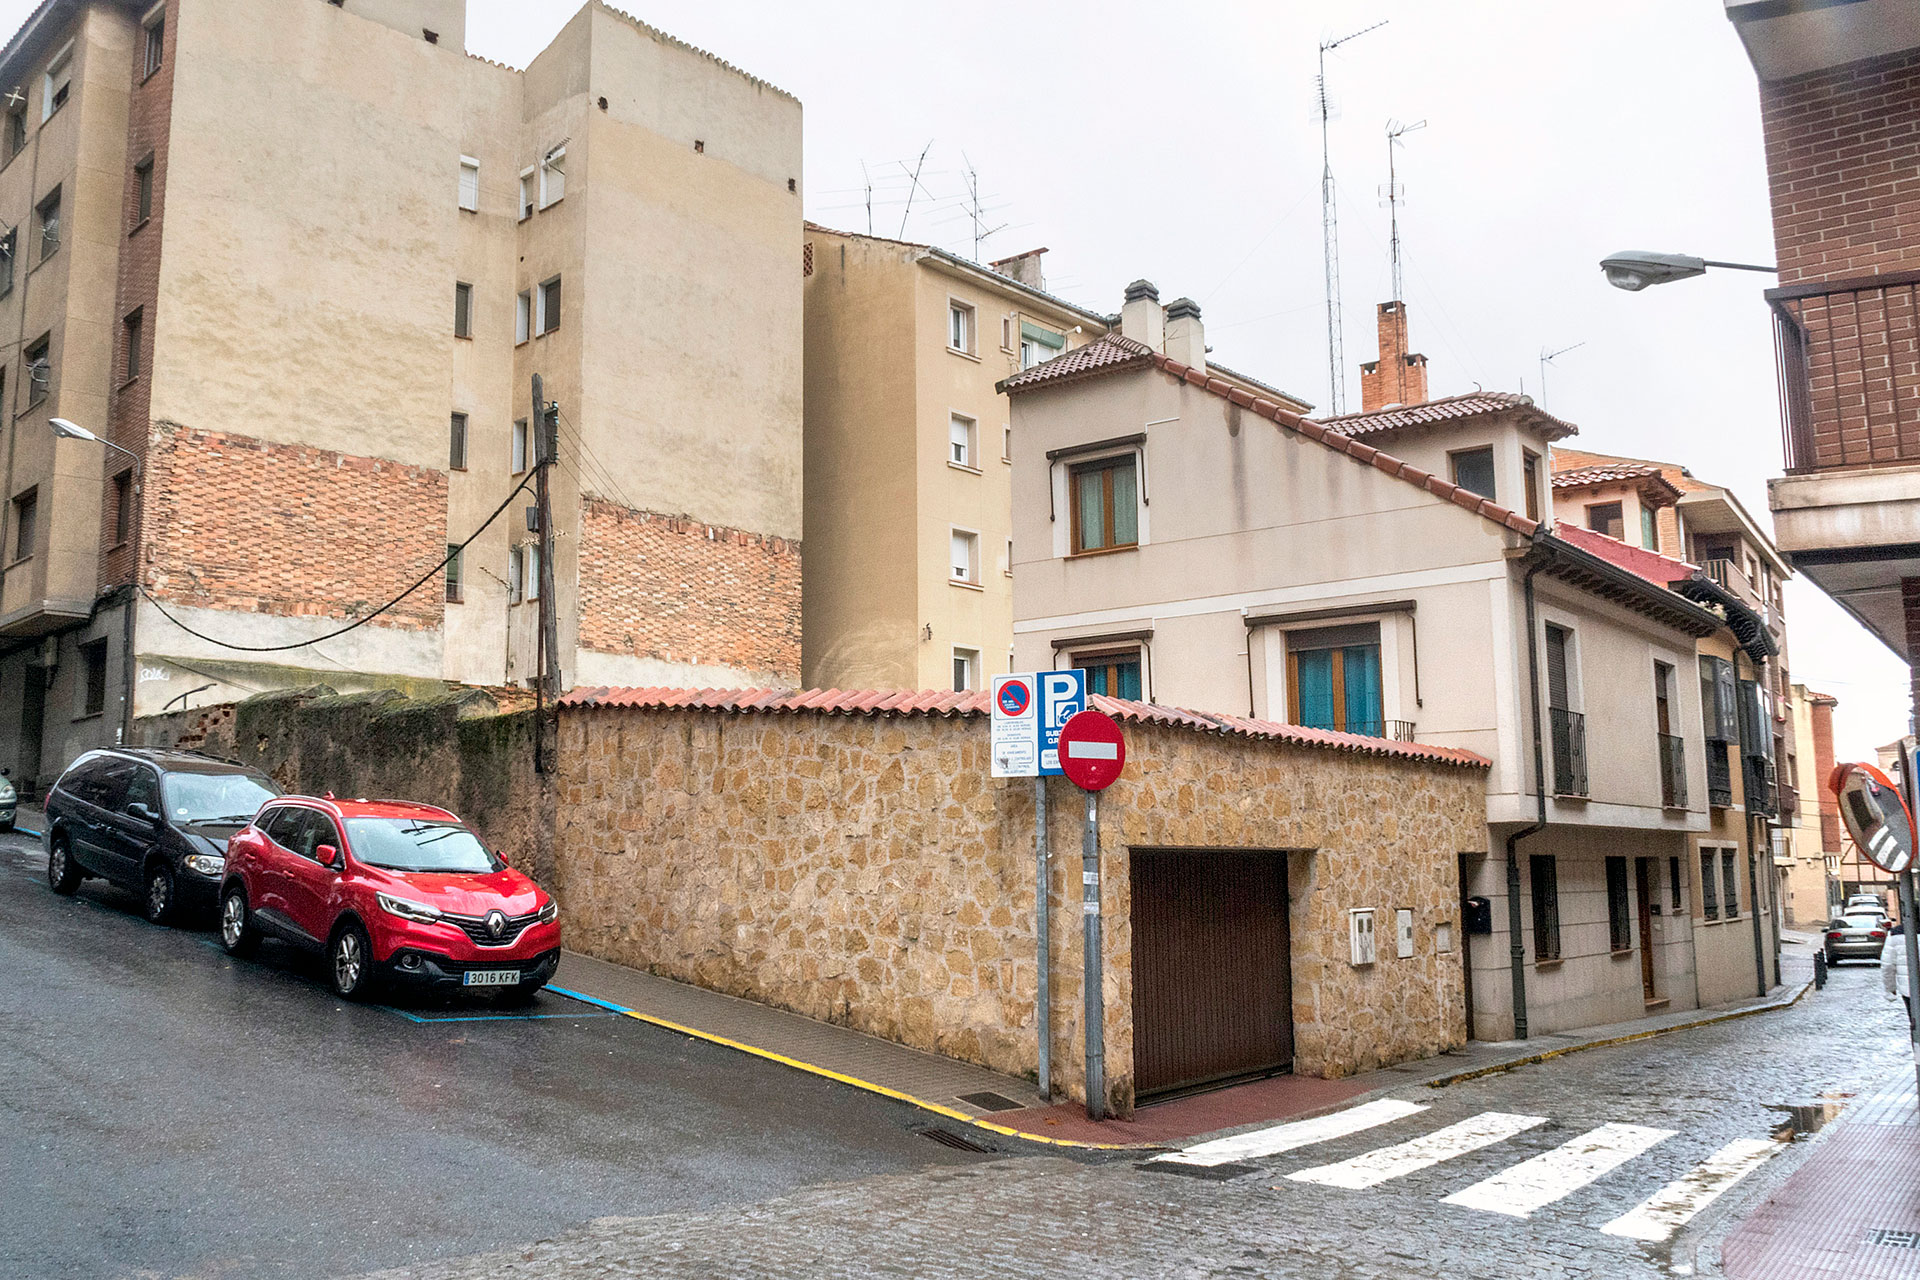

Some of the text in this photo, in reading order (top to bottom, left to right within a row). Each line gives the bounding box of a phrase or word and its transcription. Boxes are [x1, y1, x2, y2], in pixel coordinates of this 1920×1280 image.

[1044, 674, 1078, 728] P
[471, 972, 517, 983] 3016 KFK
